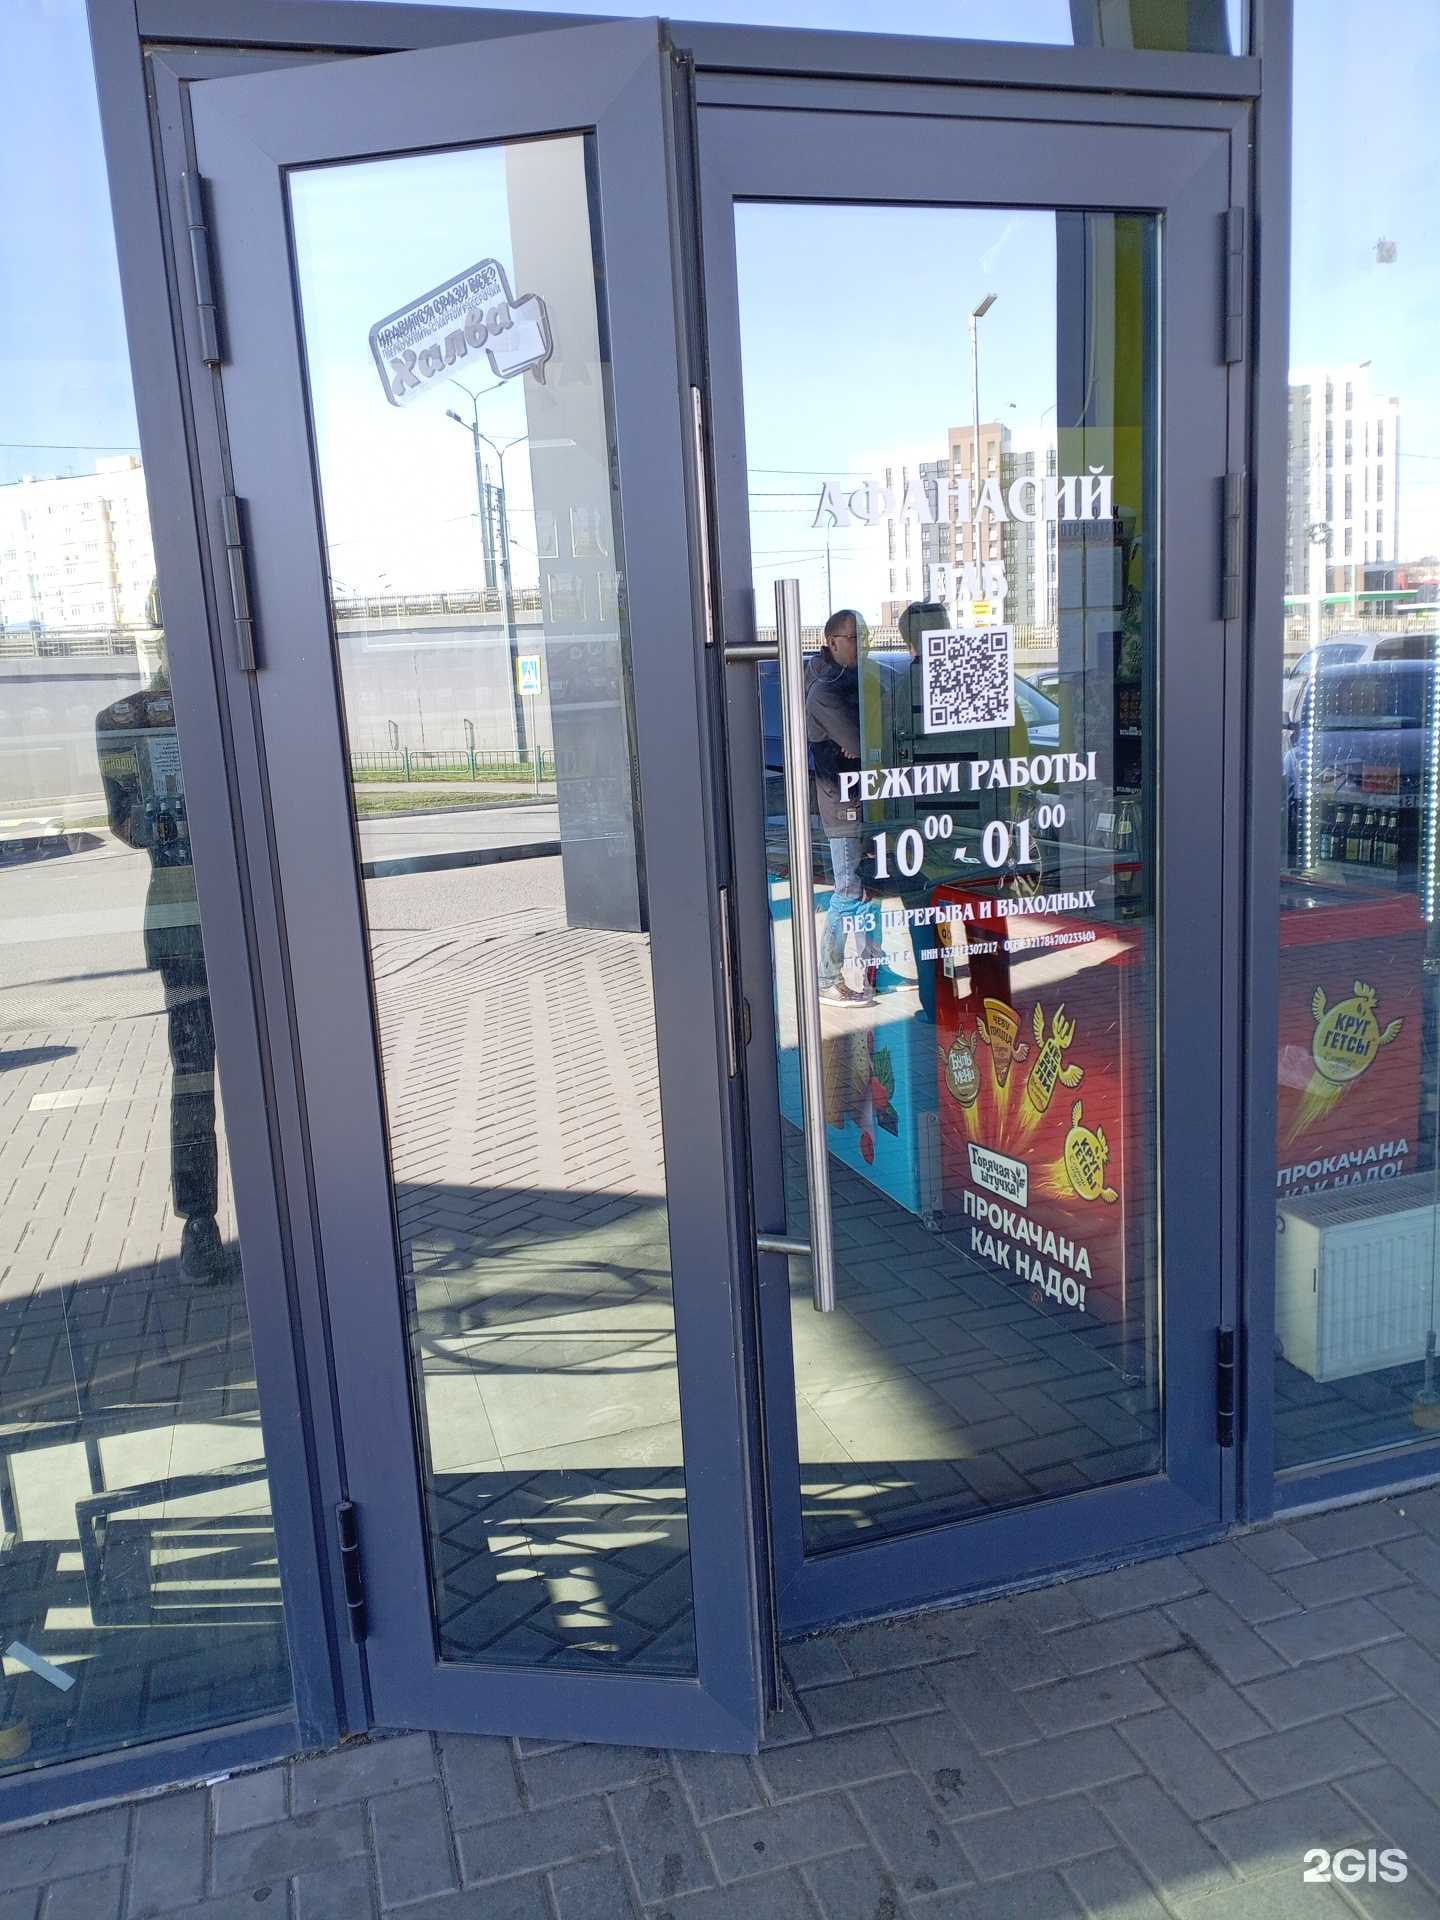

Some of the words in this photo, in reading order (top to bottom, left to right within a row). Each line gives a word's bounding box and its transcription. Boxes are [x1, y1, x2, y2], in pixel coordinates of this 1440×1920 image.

[377, 304, 435, 348] НРАВИТСЯ
[433, 283, 469, 315] СРАЗУ
[811, 465, 1114, 528] АФАНАСИЙ
[838, 762, 961, 802] РЕЖИМ
[969, 751, 1097, 791] РАБОТЫ
[842, 915, 876, 934] БЕЗ
[882, 903, 975, 927] ПЕРЕРЫВА
[980, 900, 992, 919] И
[996, 890, 1097, 918] ВЫХОДНЫХ
[940, 942, 998, 959] 132507217
[1322, 1030, 1371, 1057] ГЕТСЫ
[1334, 1012, 1371, 1038] КРУГ
[971, 1147, 1011, 1180] Горячая
[1276, 1138, 1408, 1187] ПРОКАЧАНА
[963, 1190, 1093, 1279] ПРОКАЧАНА
[971, 1227, 1010, 1269] КАК
[1015, 1250, 1087, 1312] НАДО!
